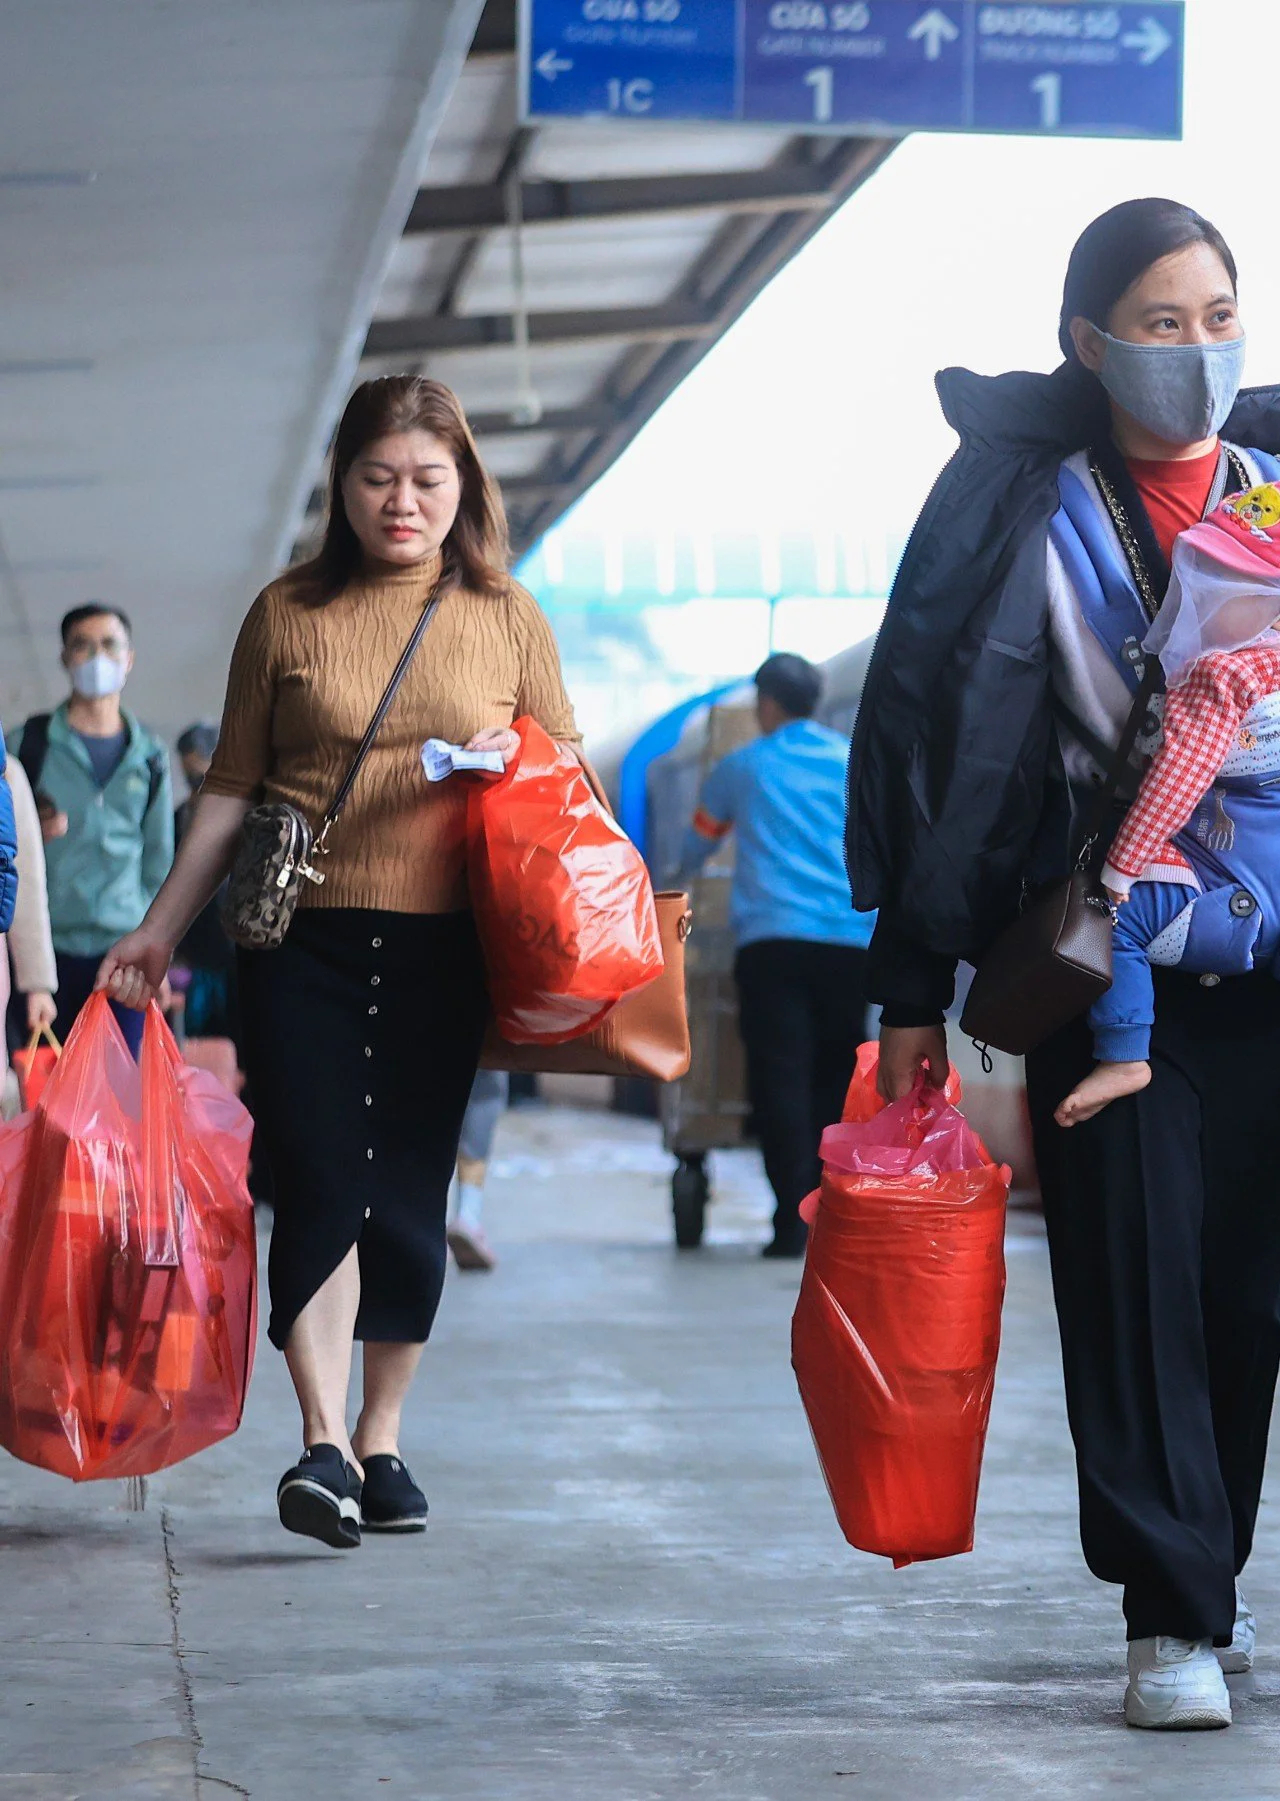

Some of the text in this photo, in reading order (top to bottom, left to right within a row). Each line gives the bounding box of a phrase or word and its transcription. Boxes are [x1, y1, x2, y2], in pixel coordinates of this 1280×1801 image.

[606, 77, 654, 113] 1C
[804, 66, 834, 122] 1
[1031, 72, 1061, 127] 1
